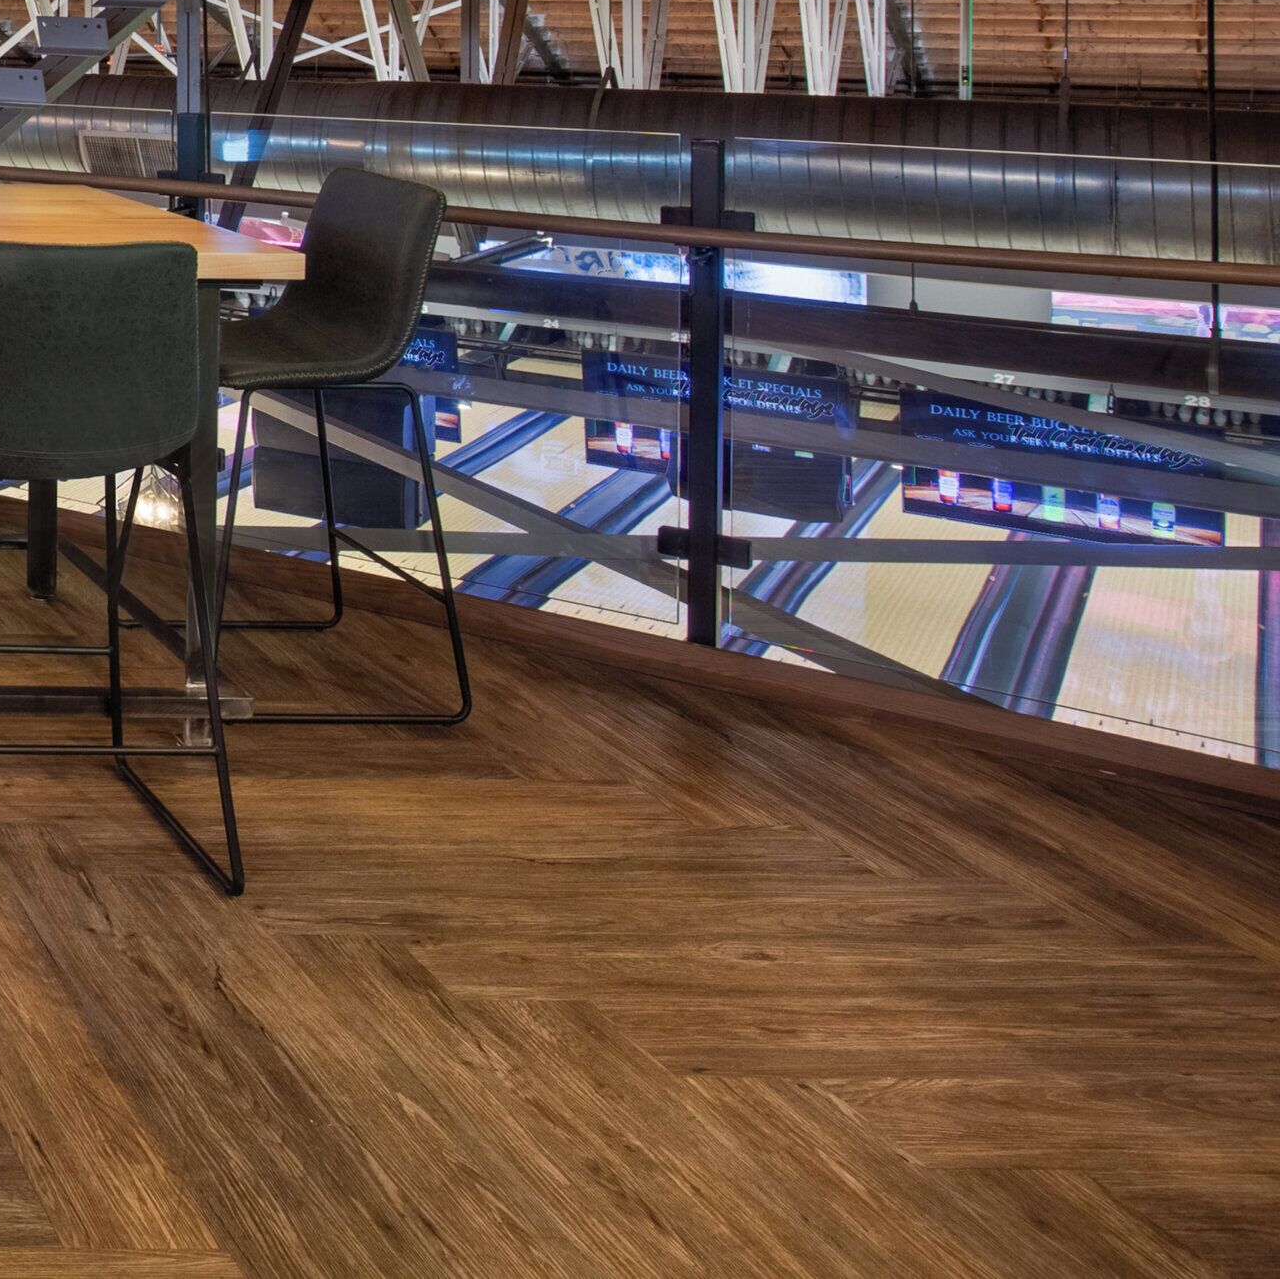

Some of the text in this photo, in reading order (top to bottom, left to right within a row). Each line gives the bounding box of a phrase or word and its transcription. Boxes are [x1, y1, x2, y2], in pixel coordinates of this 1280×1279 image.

[543, 318, 560, 329] 24
[607, 362, 648, 376] DAILY
[653, 368, 689, 381] BEER
[756, 381, 823, 399] SPECIALS
[993, 373, 1016, 385] 27
[626, 383, 645, 393] ASK
[1184, 394, 1211, 407] 28
[929, 404, 1099, 436] DAILY BEER BUCKE
[952, 428, 976, 439] ASK
[980, 431, 1018, 444] YOUR
[1074, 444, 1101, 455] FOR
